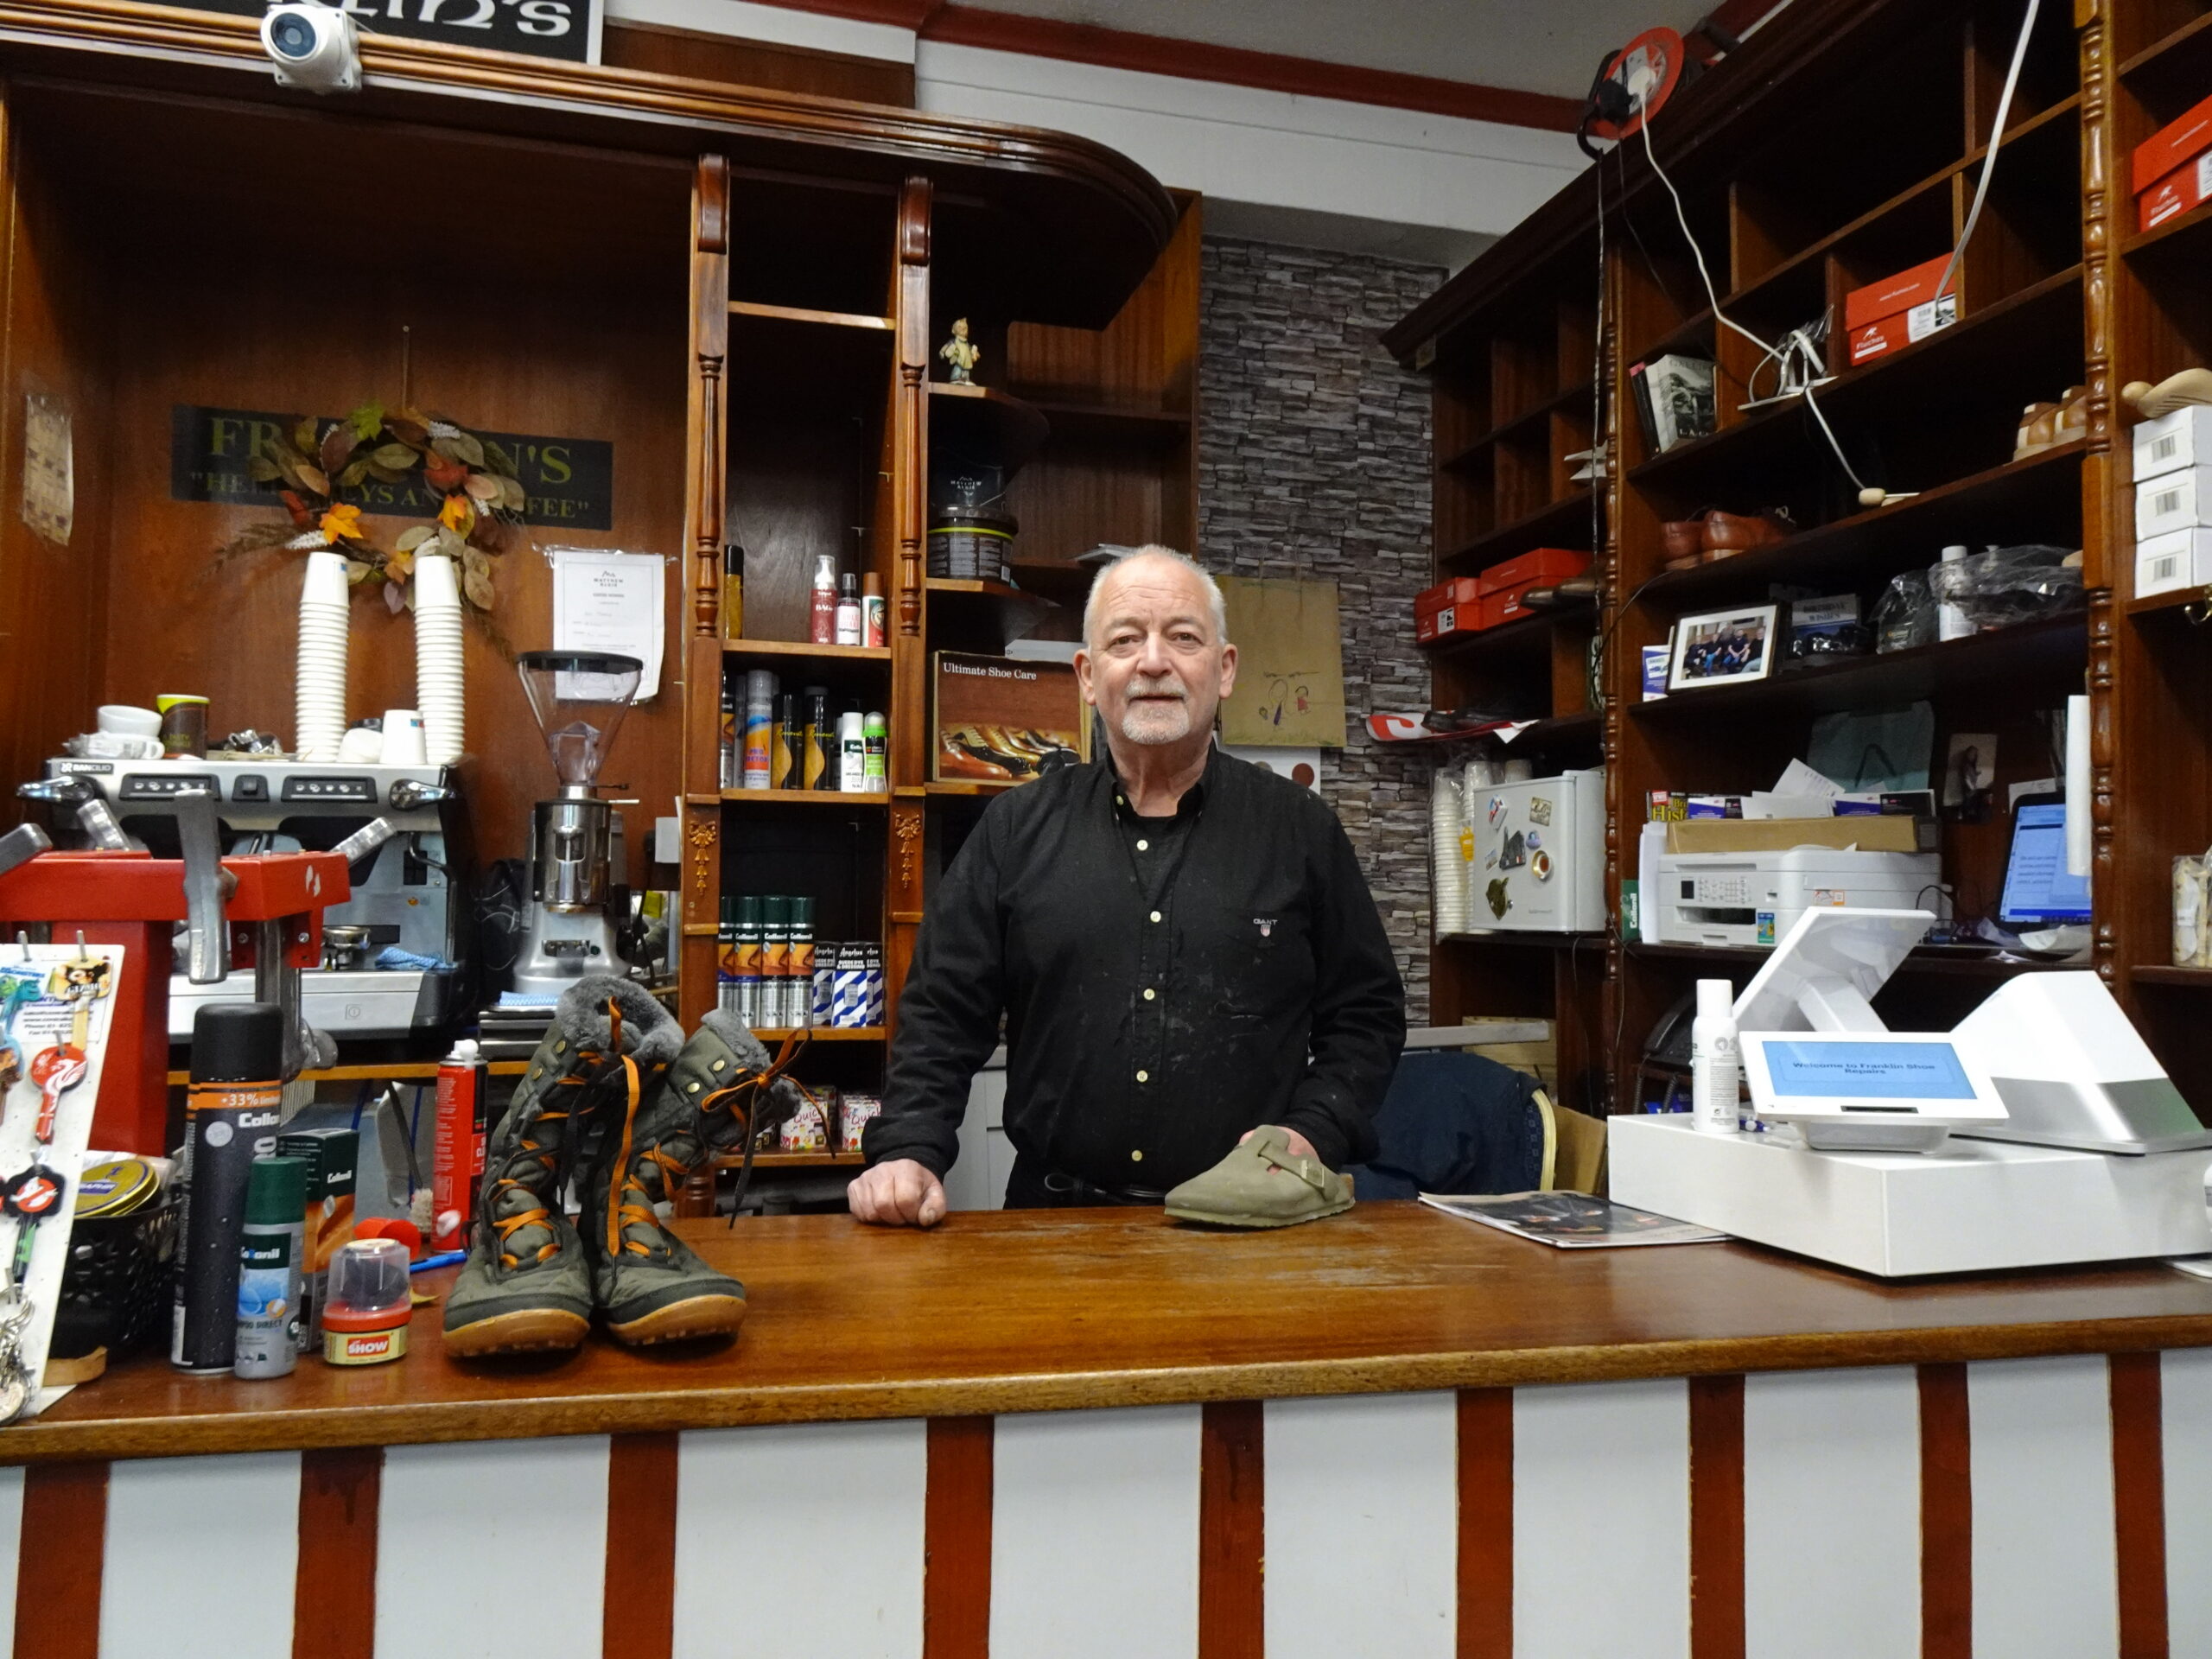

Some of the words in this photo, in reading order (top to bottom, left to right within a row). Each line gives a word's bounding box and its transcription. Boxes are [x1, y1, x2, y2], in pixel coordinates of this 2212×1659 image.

[943, 662, 987, 676] Ultimate
[988, 666, 1012, 678] Shoe
[1014, 669, 1037, 680] Care
